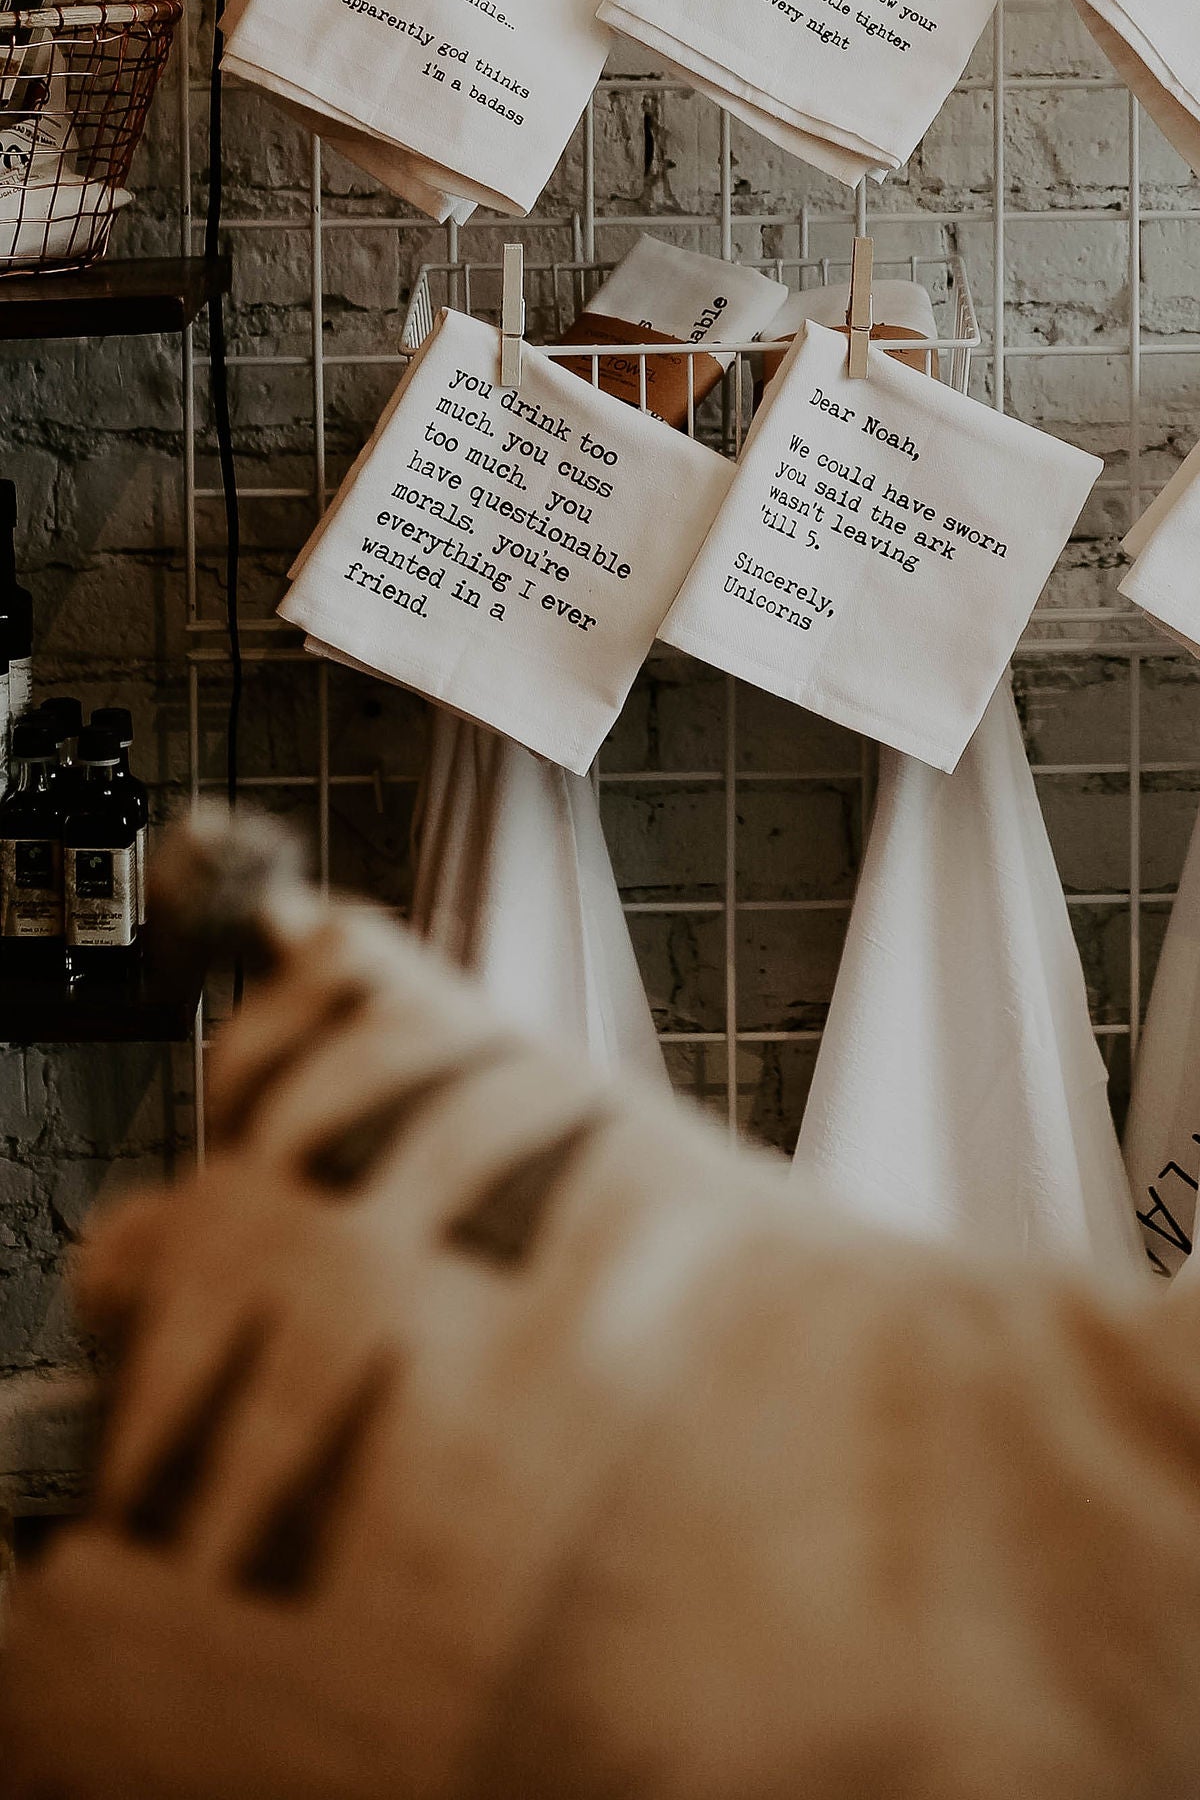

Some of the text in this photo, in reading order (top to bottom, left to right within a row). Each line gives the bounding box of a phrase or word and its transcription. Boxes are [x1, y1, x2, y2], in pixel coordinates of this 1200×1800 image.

[805, 17, 851, 51] night
[855, 10, 912, 52] tighter
[898, 5, 938, 33] your
[436, 42, 470, 64] god
[474, 58, 531, 100] thinks
[686, 296, 728, 345] able
[435, 396, 614, 499] much. you cuss
[447, 369, 619, 466] you drink too
[808, 387, 920, 462] Dear Noah,
[405, 448, 632, 580] have questionable
[424, 421, 593, 525] too much. you
[774, 461, 957, 561] you said the ark
[788, 433, 1008, 559] We could have sworn
[390, 482, 570, 583] morals. you're
[769, 485, 921, 574] wasn't leaving
[343, 562, 429, 619] friend.
[376, 510, 597, 632] everything I ever
[723, 574, 813, 631] Unicorns
[733, 551, 835, 619] Sincerely,
